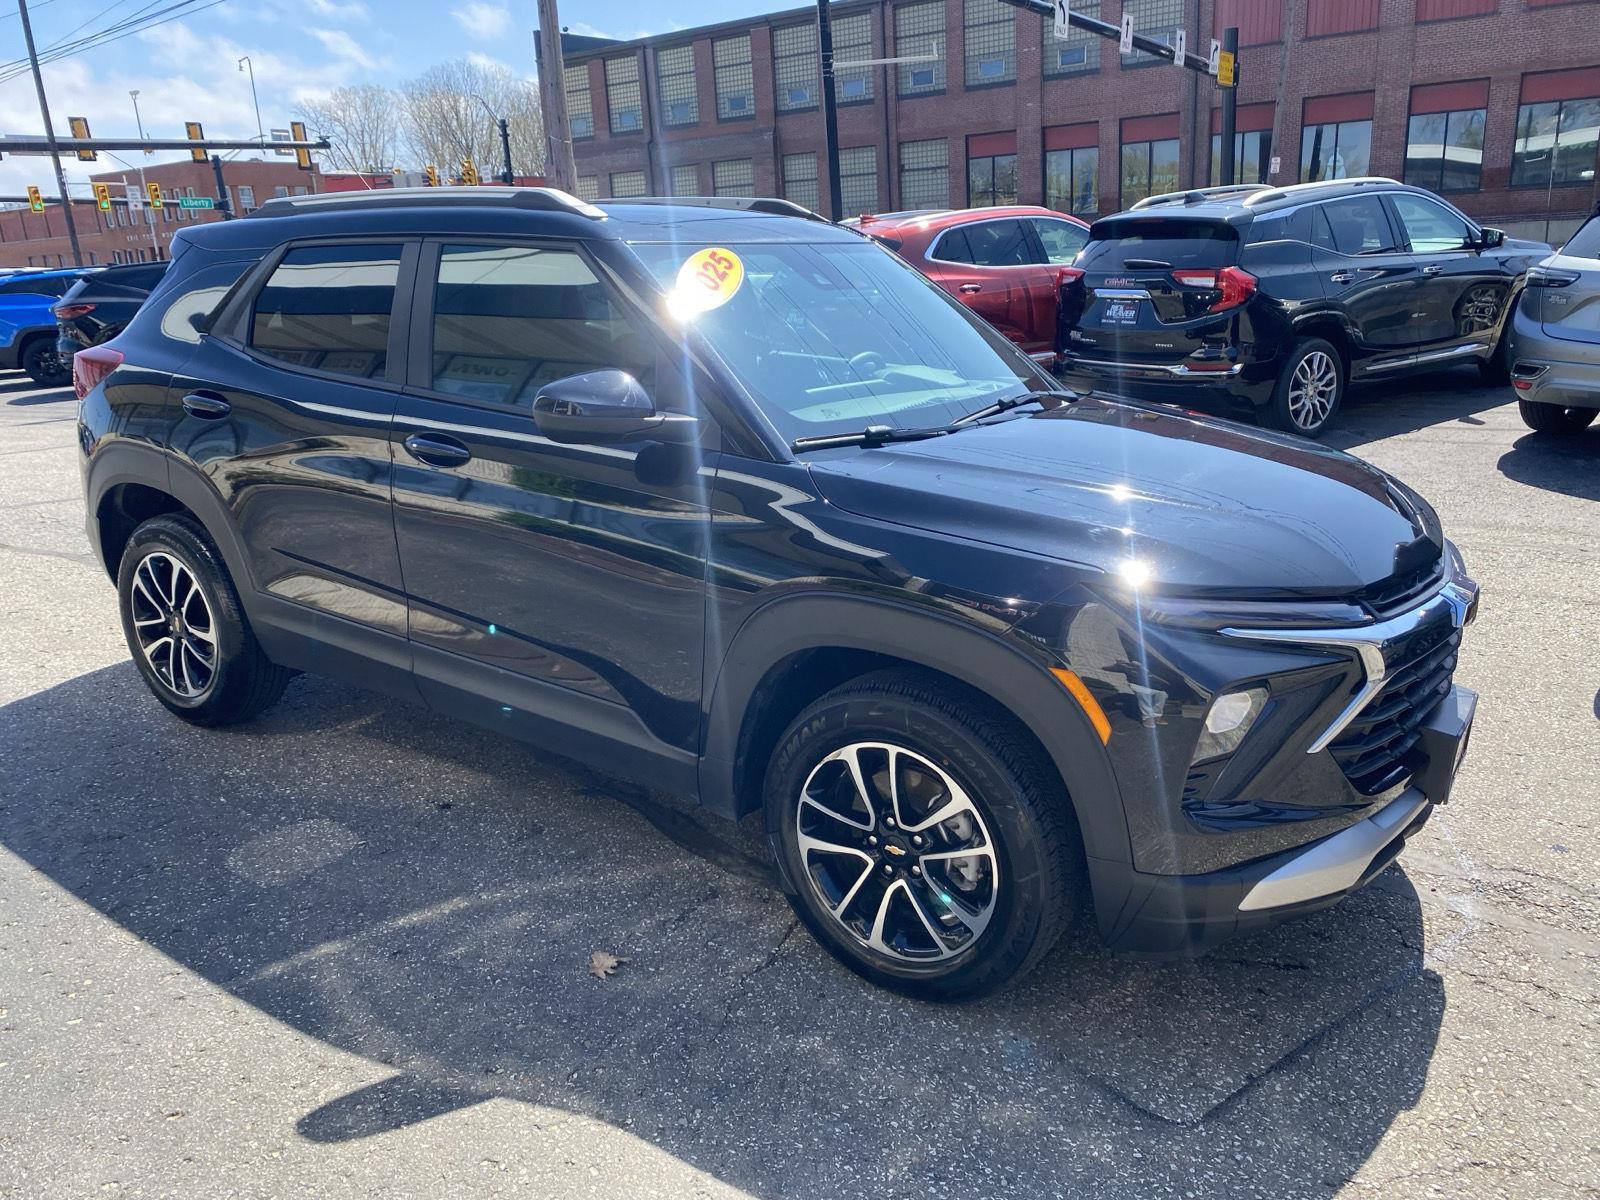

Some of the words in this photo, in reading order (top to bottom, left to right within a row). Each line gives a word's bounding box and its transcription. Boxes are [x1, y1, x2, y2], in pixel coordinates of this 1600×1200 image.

[183, 198, 209, 208] Liberty
[696, 250, 734, 291] 025
[1104, 278, 1135, 286] GMC
